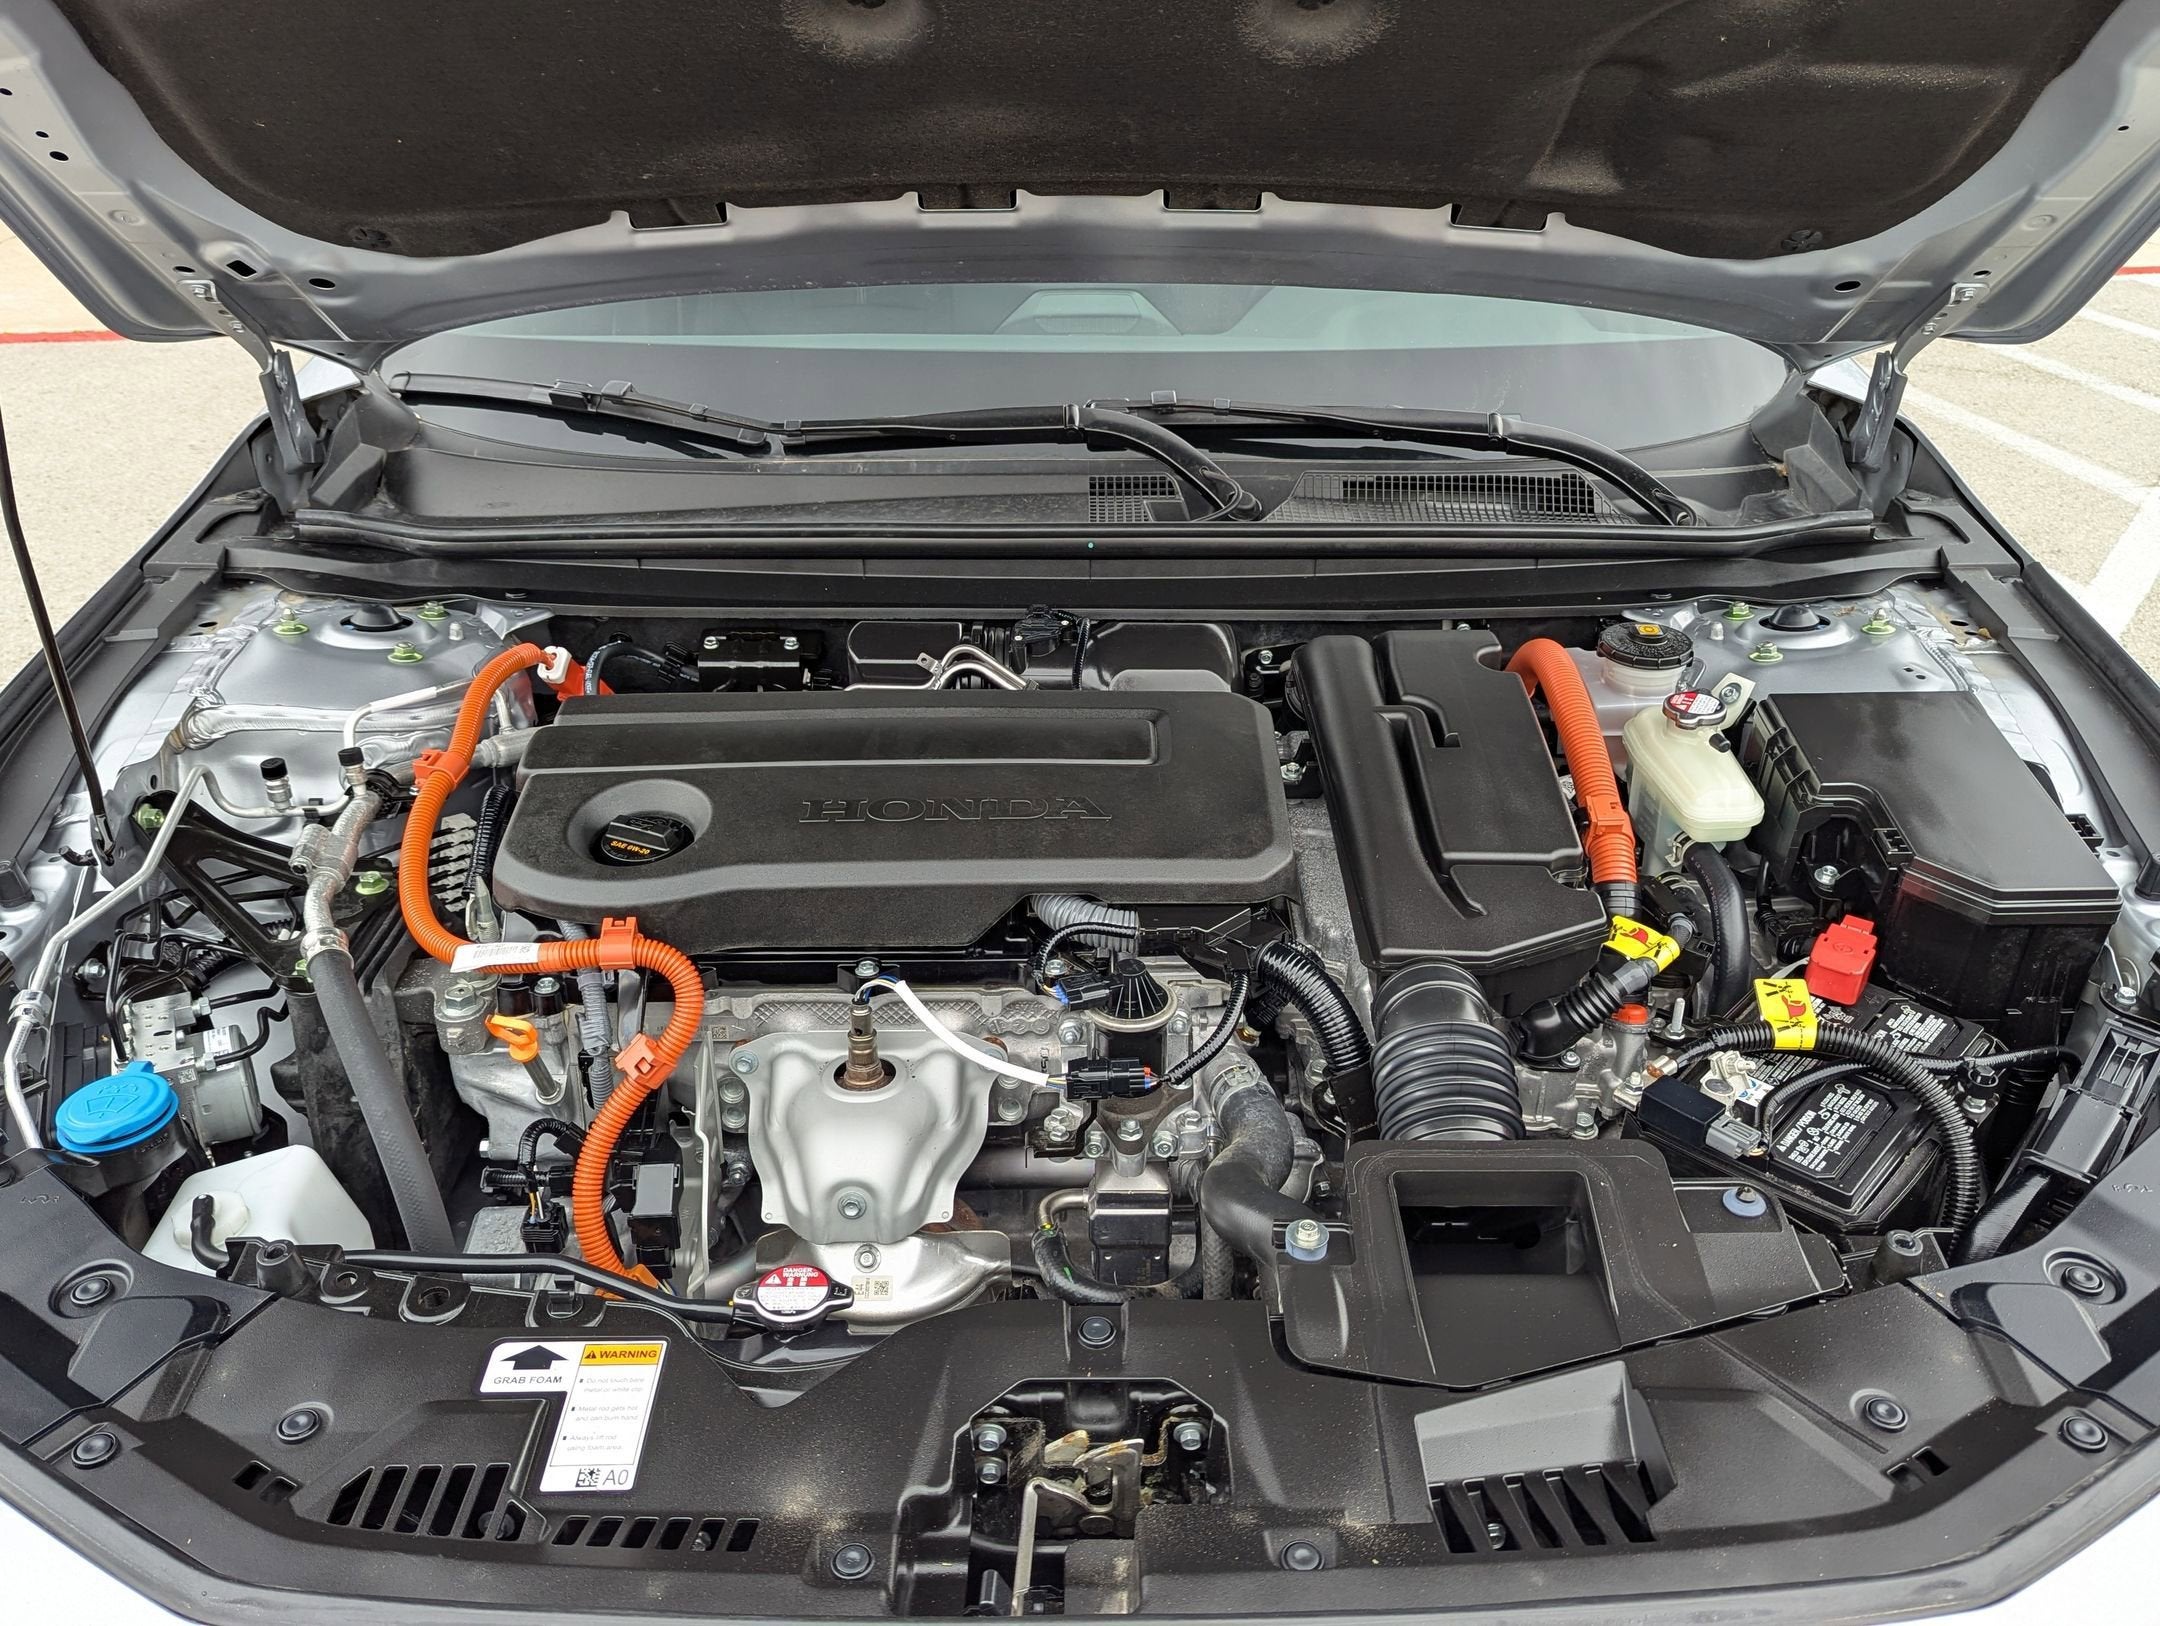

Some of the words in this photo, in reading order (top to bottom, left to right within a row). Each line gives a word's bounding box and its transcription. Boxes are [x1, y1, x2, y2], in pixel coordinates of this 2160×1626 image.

[799, 798, 1113, 823] HONDA
[610, 840, 626, 849] SAE
[627, 843, 651, 855] 0W-20
[599, 1349, 658, 1359] WARNING
[493, 1376, 526, 1385] GRAB
[530, 1375, 563, 1384] FOAM
[603, 1469, 630, 1486] A0
